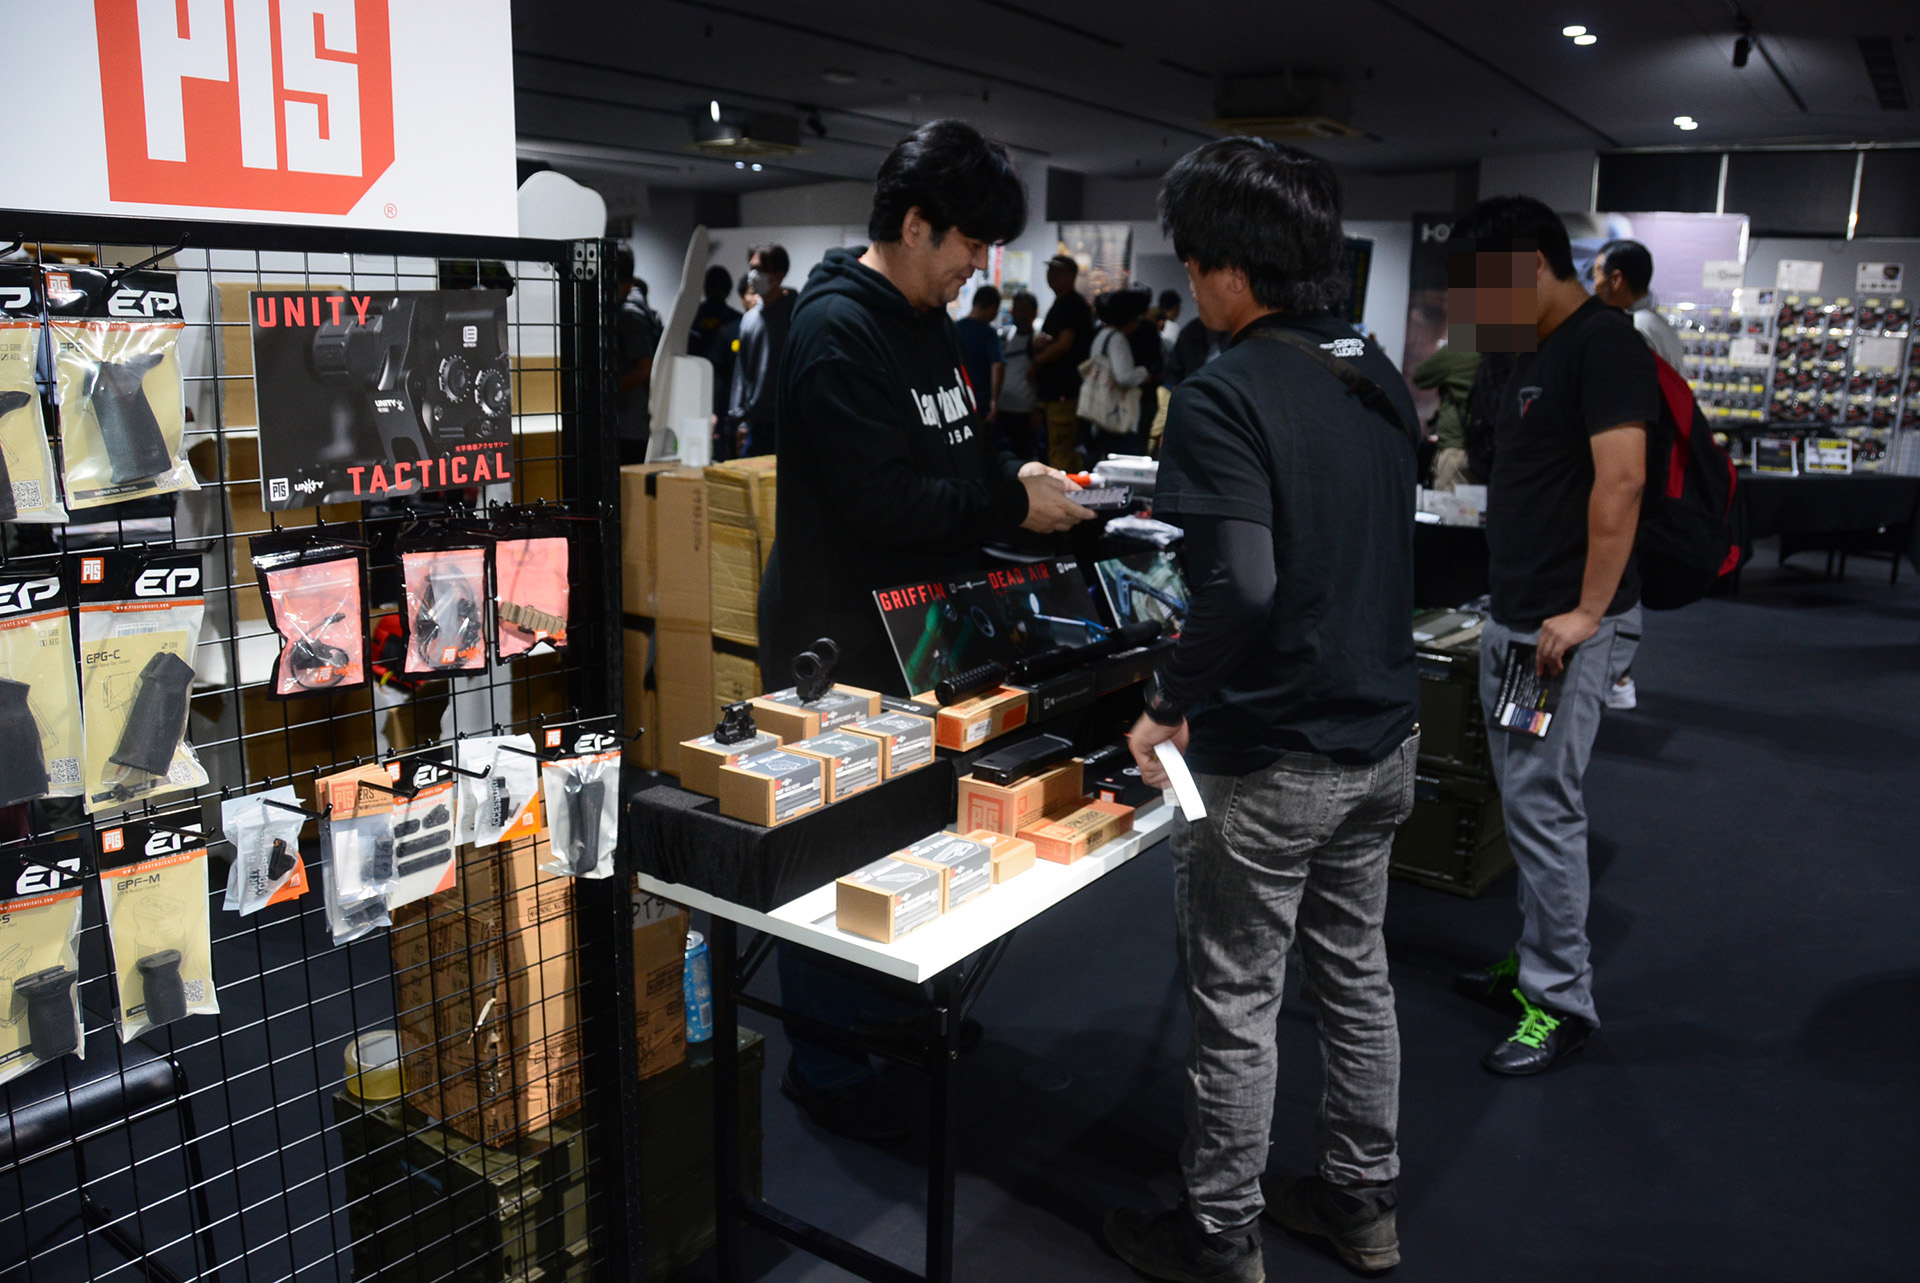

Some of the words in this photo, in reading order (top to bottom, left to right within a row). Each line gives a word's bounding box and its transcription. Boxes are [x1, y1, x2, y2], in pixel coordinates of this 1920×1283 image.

[107, 289, 178, 317] EP
[256, 296, 371, 328] UNITY
[346, 452, 511, 496] TACTICAL
[82, 559, 103, 582] PTS
[134, 567, 200, 597] EP
[987, 568, 1025, 590] DEAD
[1027, 562, 1051, 582] AIR
[878, 582, 948, 612] GRIFFIN
[86, 649, 121, 665] EPG-C
[574, 729, 616, 754] EP
[412, 759, 453, 788] EP
[104, 830, 123, 851] PTS
[145, 823, 202, 857] EP
[16, 857, 81, 895] EP
[117, 873, 160, 891] EPF-M
